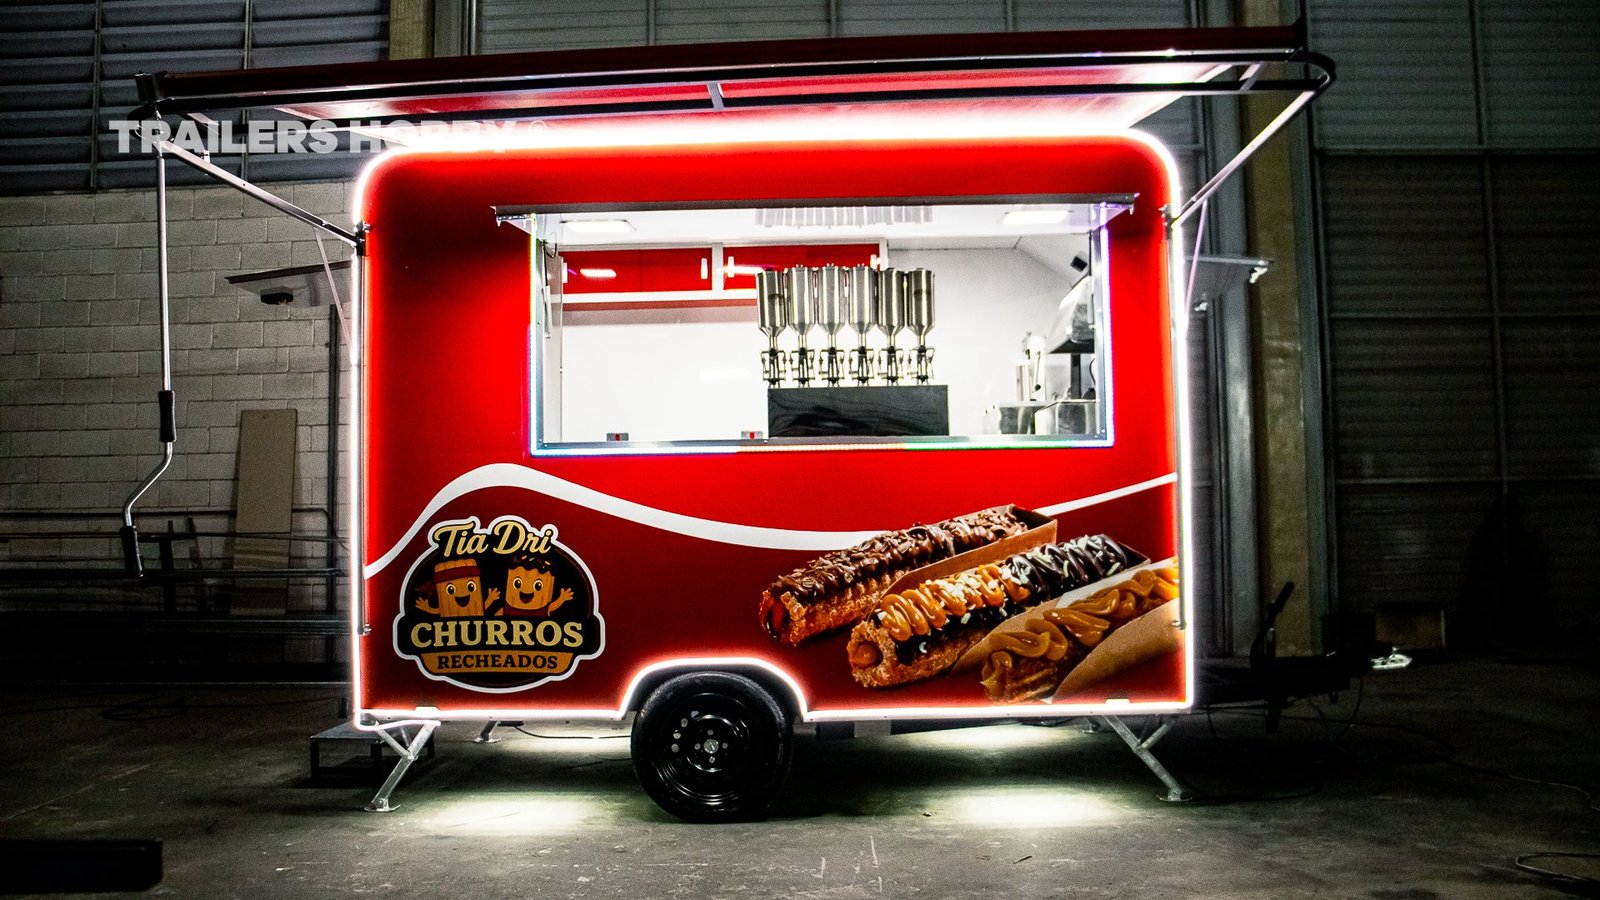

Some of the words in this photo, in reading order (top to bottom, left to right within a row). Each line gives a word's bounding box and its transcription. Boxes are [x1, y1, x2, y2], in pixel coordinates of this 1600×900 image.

[433, 521, 489, 557] Tia
[493, 520, 552, 554] Dri
[410, 620, 584, 648] CHURROS
[437, 654, 558, 669] RECHEADOS
